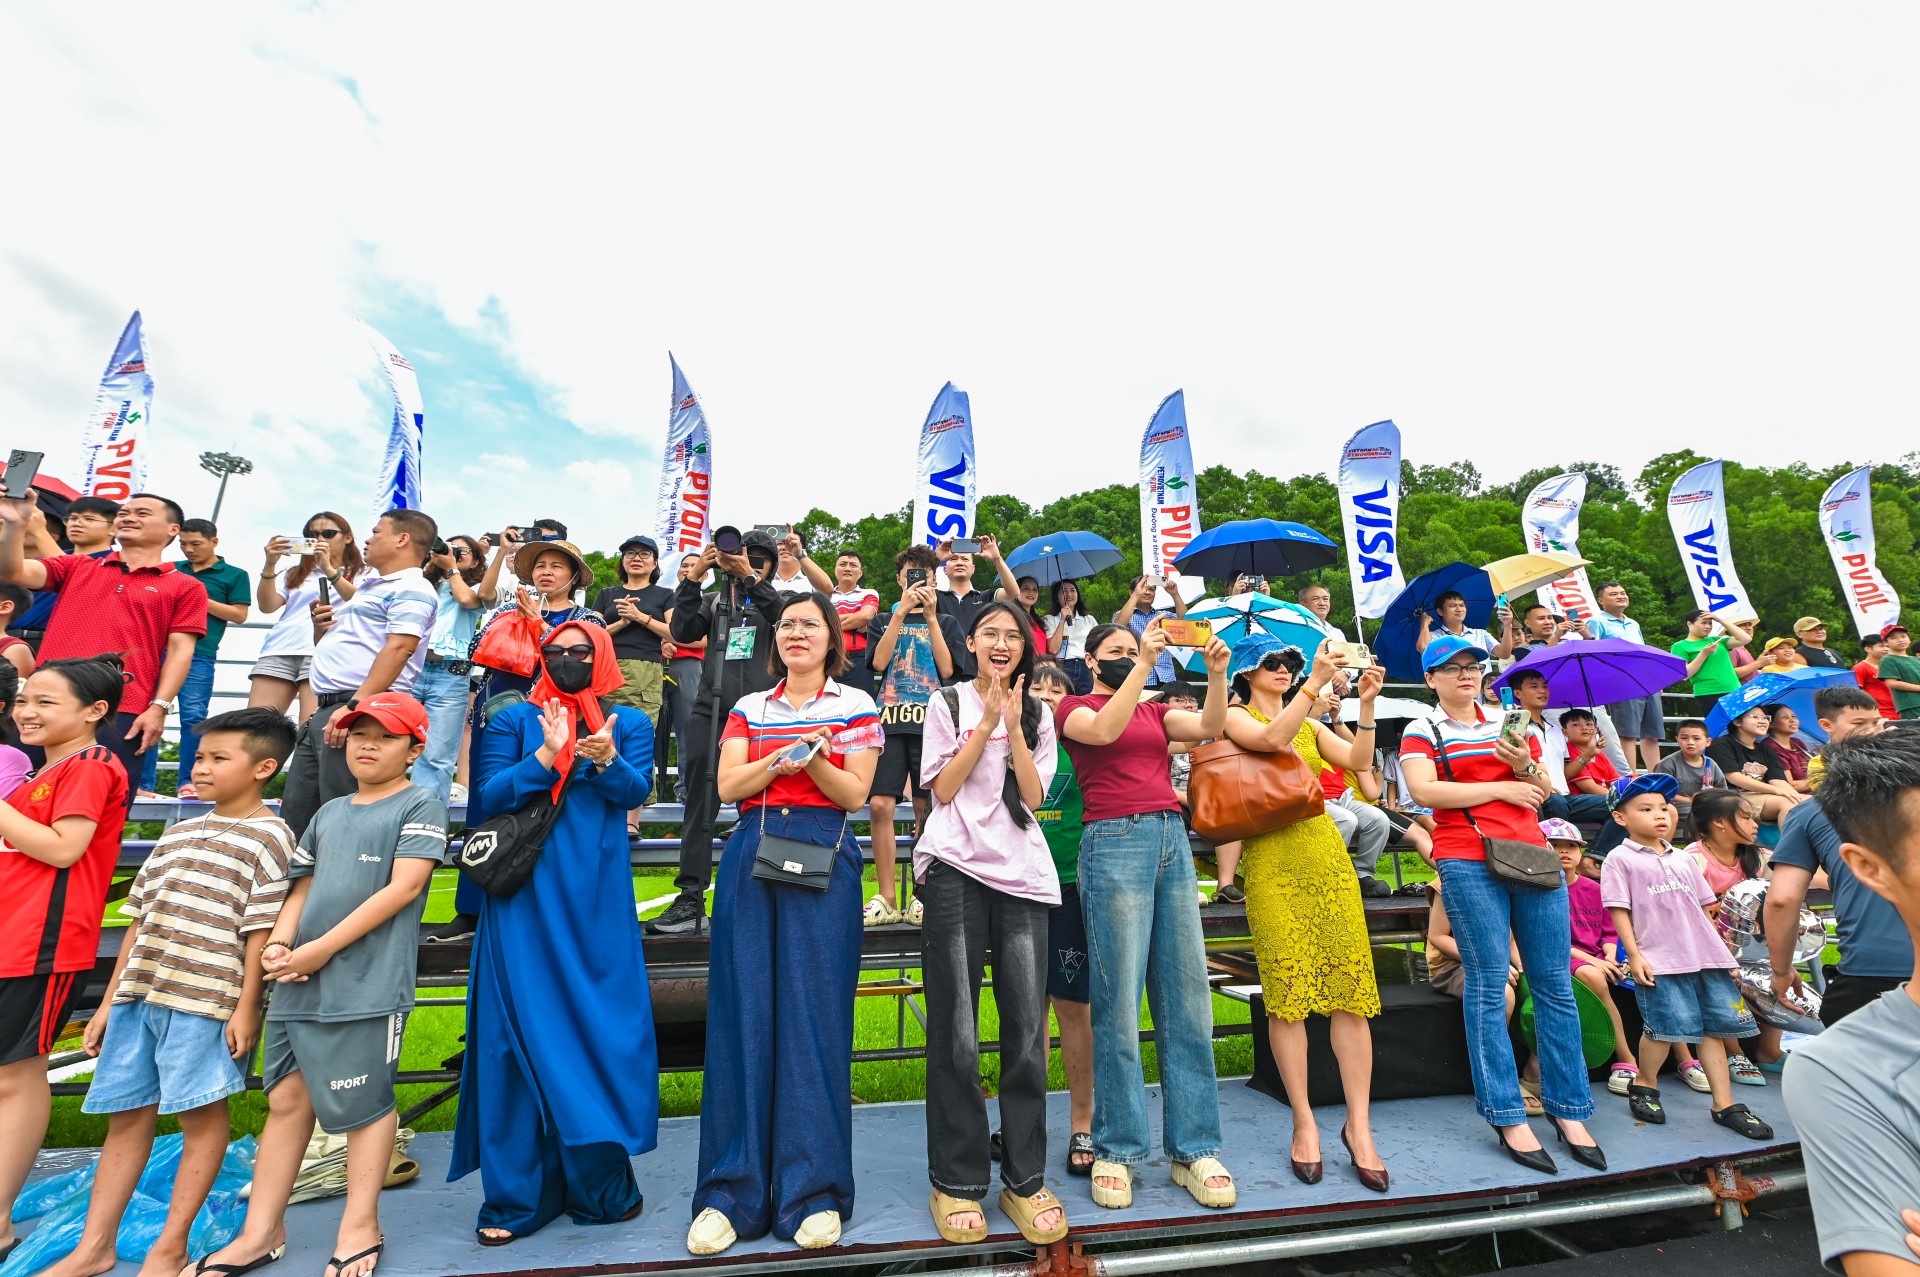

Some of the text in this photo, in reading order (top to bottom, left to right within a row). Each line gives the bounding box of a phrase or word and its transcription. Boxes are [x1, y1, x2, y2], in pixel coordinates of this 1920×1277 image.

[93, 438, 136, 505] PVO
[675, 444, 684, 463] PVOIL
[678, 471, 709, 553] PVOIL
[926, 451, 967, 552] VIS
[1156, 466, 1165, 505] PETROVIETNAM
[1152, 534, 1158, 543] xa
[1352, 479, 1395, 584] VISA
[1683, 518, 1739, 613] VISA
[1841, 553, 1890, 614] PVOIL
[877, 704, 927, 725] AIGO
[330, 1074, 369, 1091] SPORT
